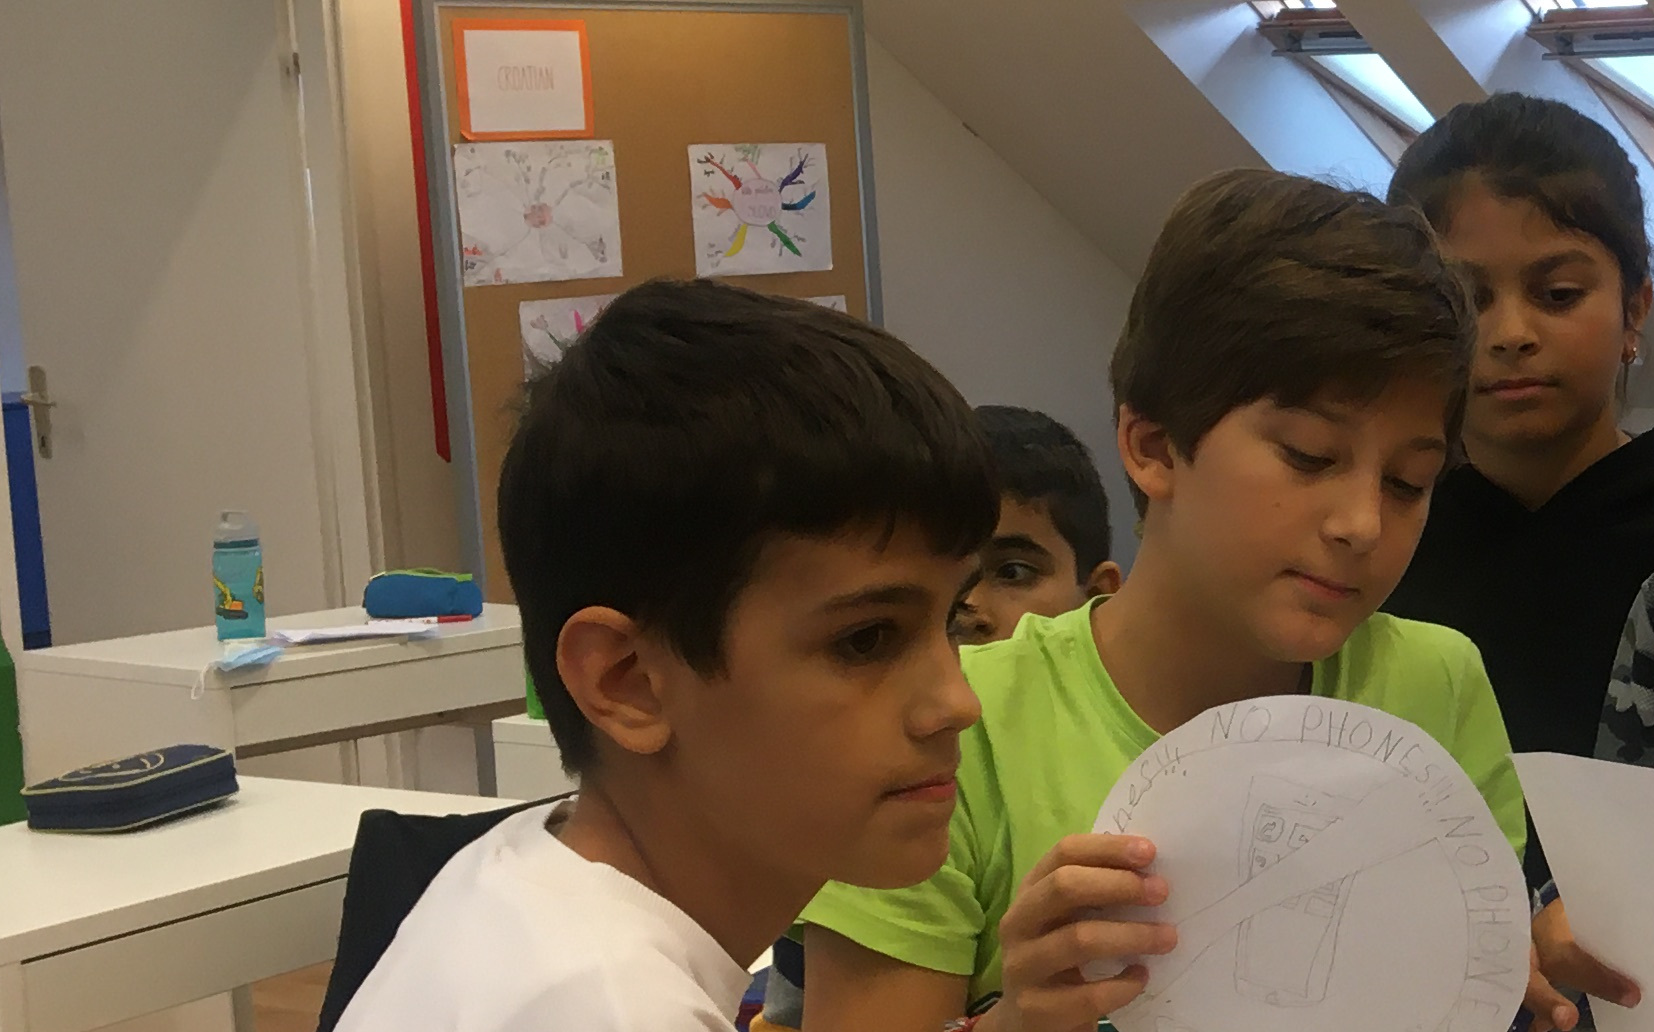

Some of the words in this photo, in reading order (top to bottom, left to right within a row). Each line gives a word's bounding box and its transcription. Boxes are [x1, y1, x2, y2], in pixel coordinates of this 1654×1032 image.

[497, 65, 554, 91] CROATIAN
[1211, 703, 1271, 743] NO
[1439, 812, 1489, 867] NO
